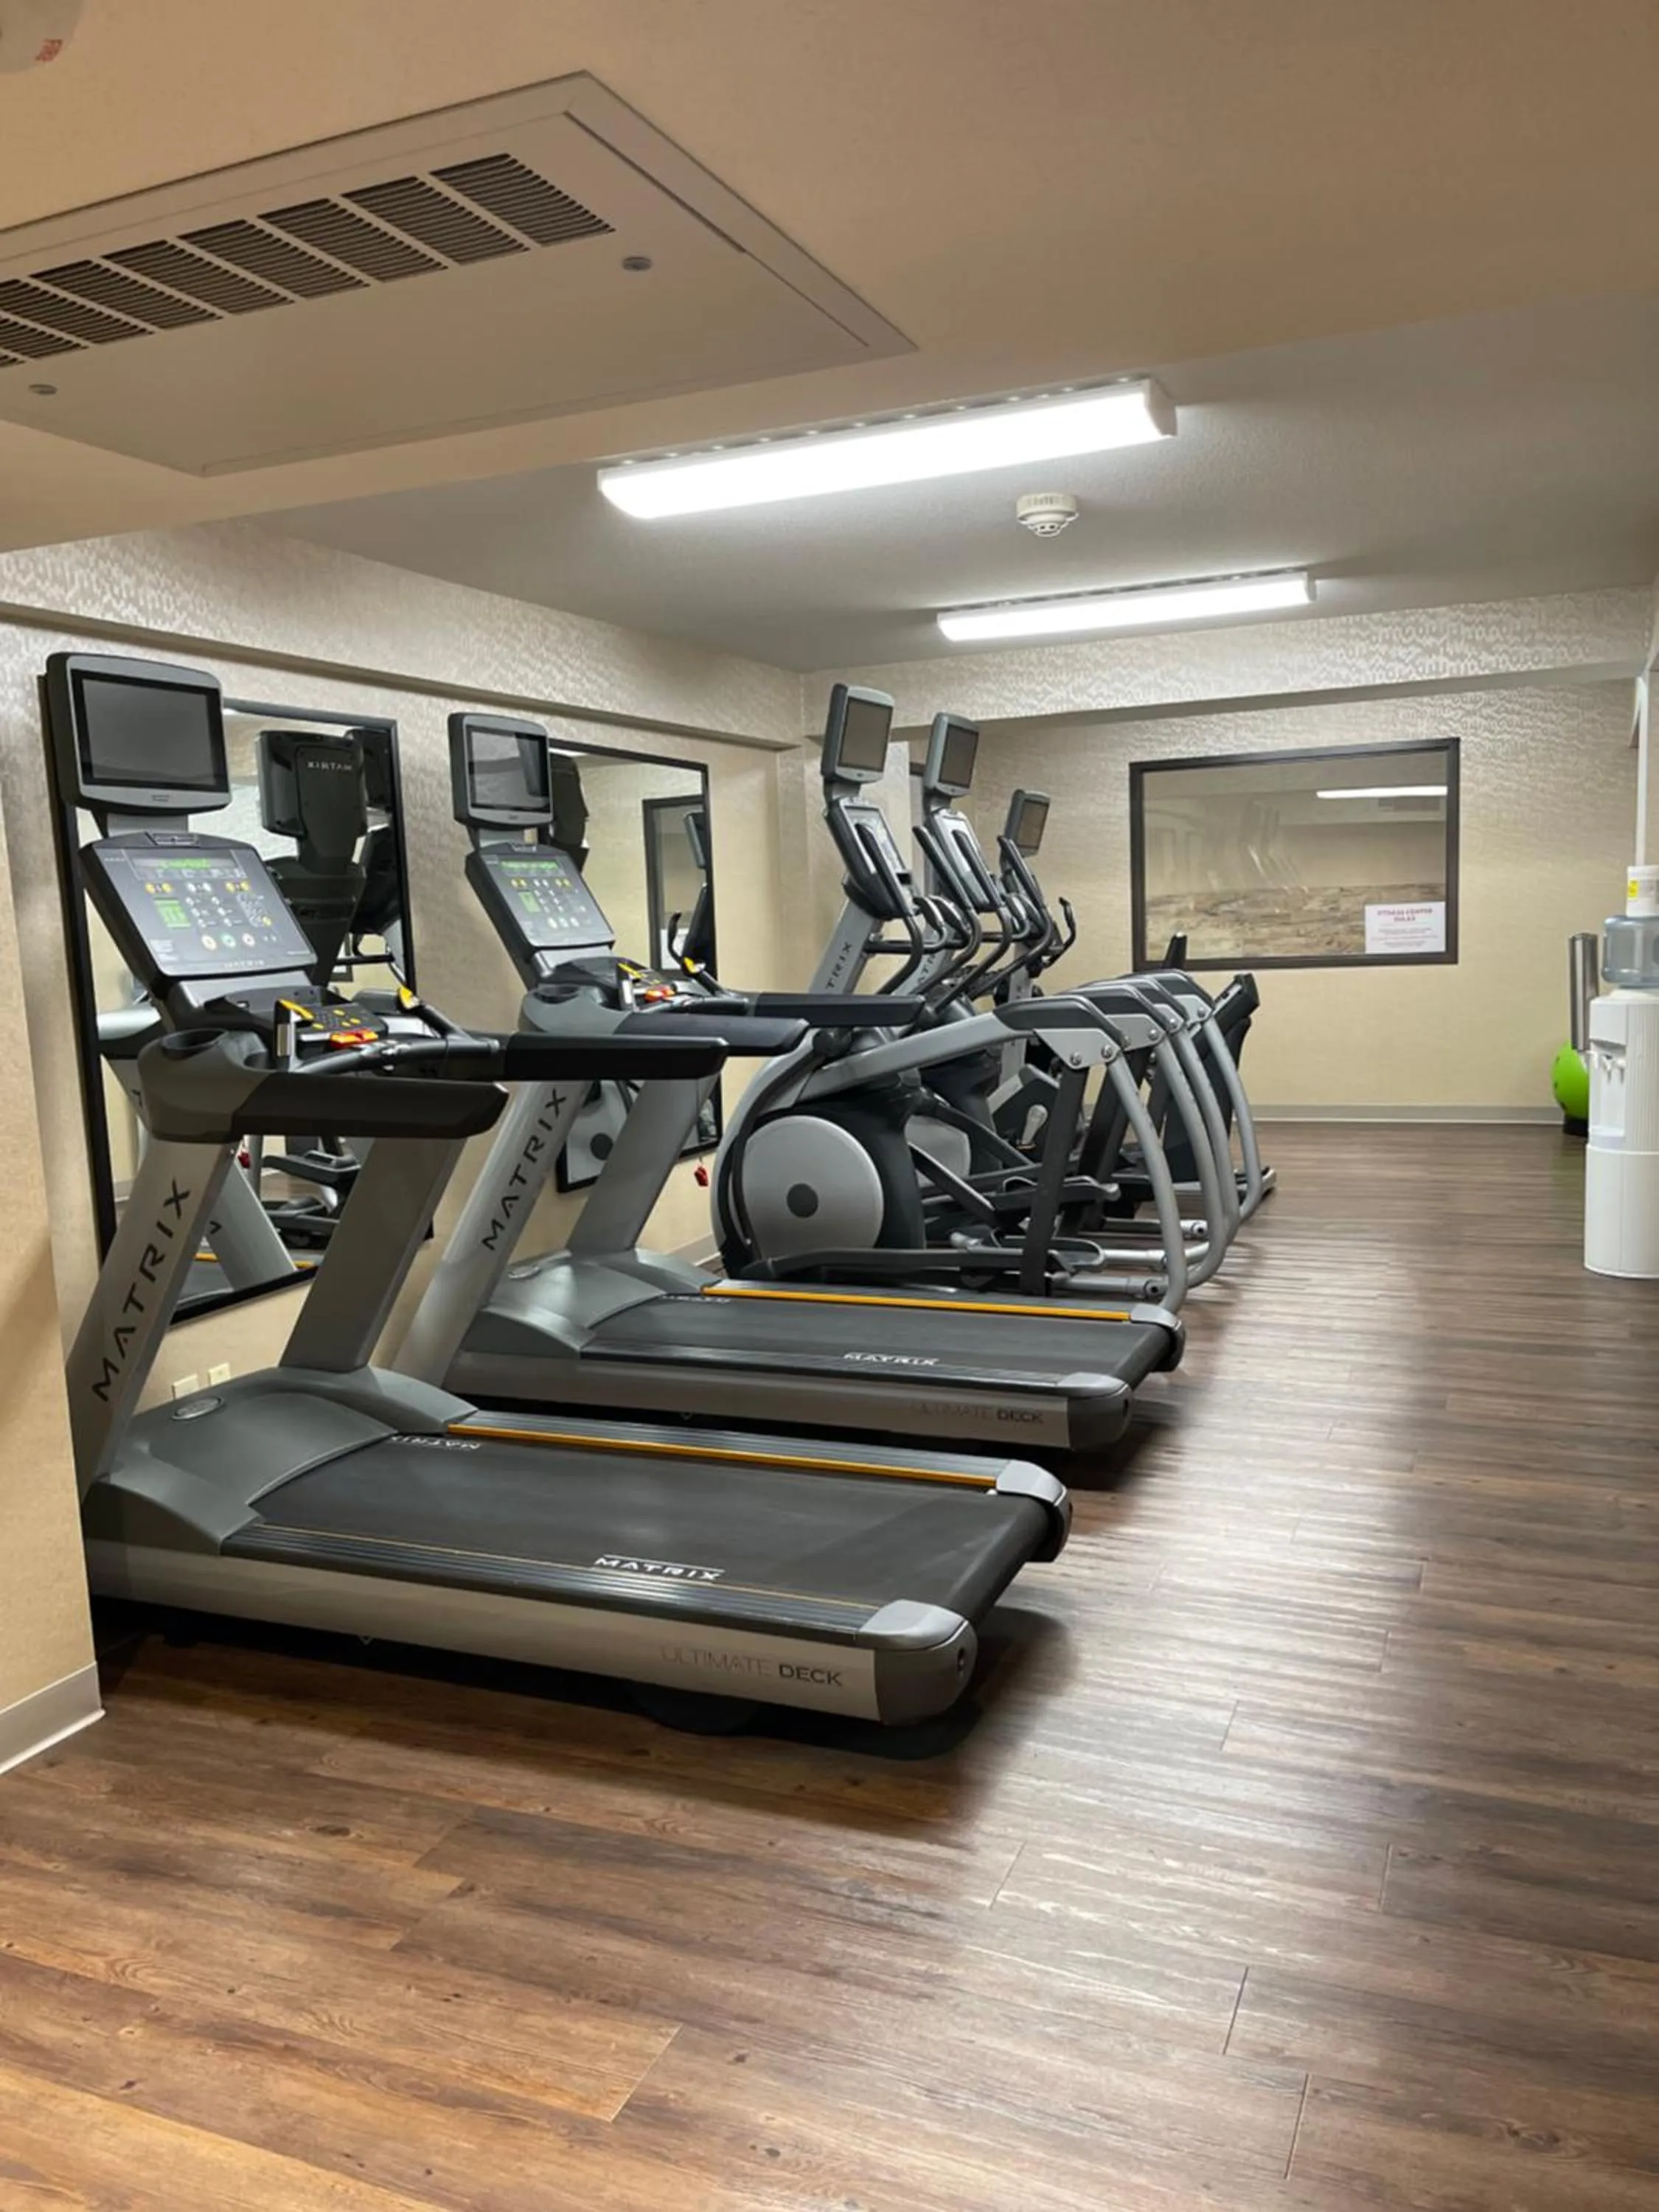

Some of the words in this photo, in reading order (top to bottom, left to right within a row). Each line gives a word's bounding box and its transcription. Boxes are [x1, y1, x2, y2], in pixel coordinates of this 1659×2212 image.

[825, 942, 852, 989] TRIX
[481, 1088, 567, 1251] MATRIX
[91, 1177, 191, 1402] MATRIX
[843, 1352, 941, 1366] MATRIX
[997, 1408, 1045, 1425] DECK
[594, 1557, 722, 1580] MATRIX
[659, 1644, 771, 1677] ULTIMATE
[778, 1663, 844, 1687] DECK
